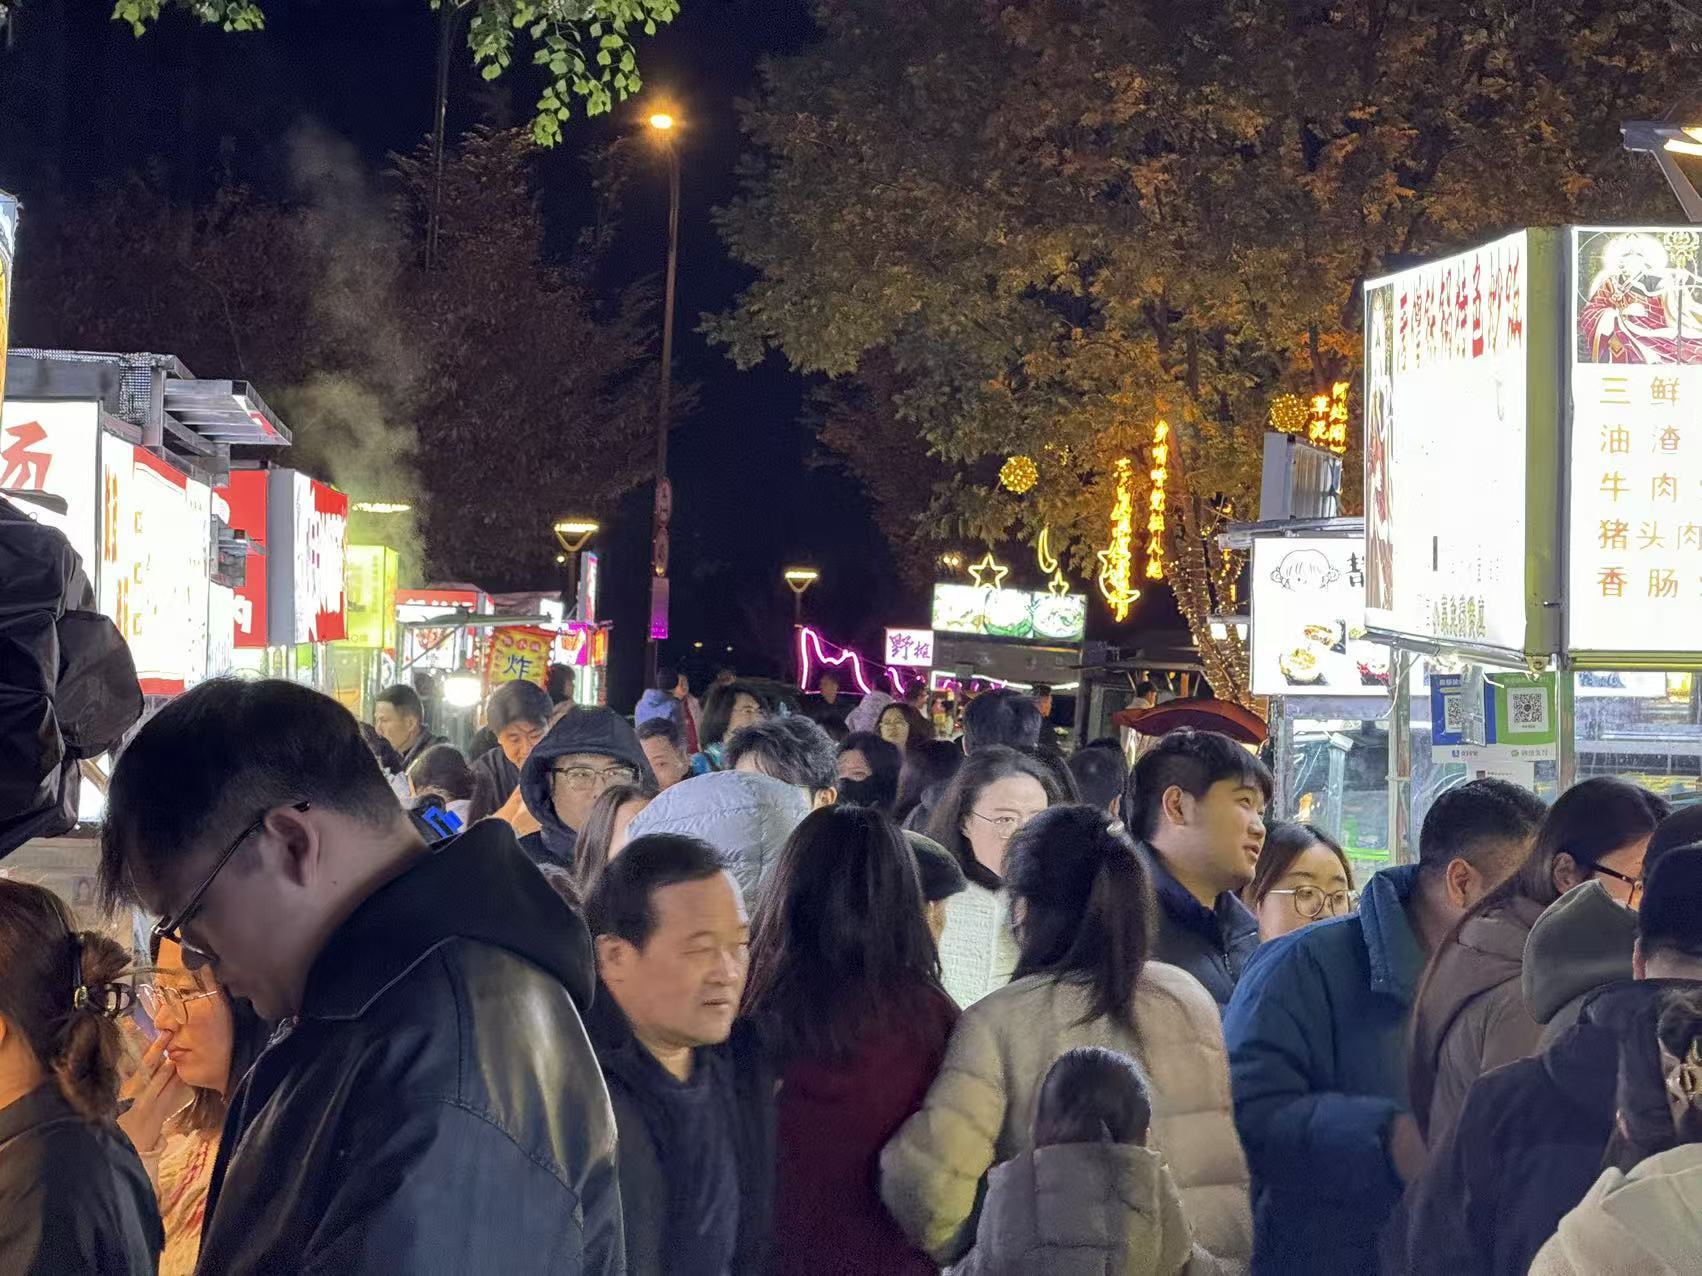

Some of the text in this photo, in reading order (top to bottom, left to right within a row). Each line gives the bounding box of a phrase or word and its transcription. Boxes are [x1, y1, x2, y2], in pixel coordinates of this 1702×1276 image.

[1600, 376, 1681, 407] 三鲜
[1600, 424, 1681, 455] 油渣
[1599, 471, 1678, 503] 牛肉
[1598, 518, 1702, 551] 猪头肉
[1597, 566, 1679, 598] 香肠
[503, 654, 532, 680] 炸
